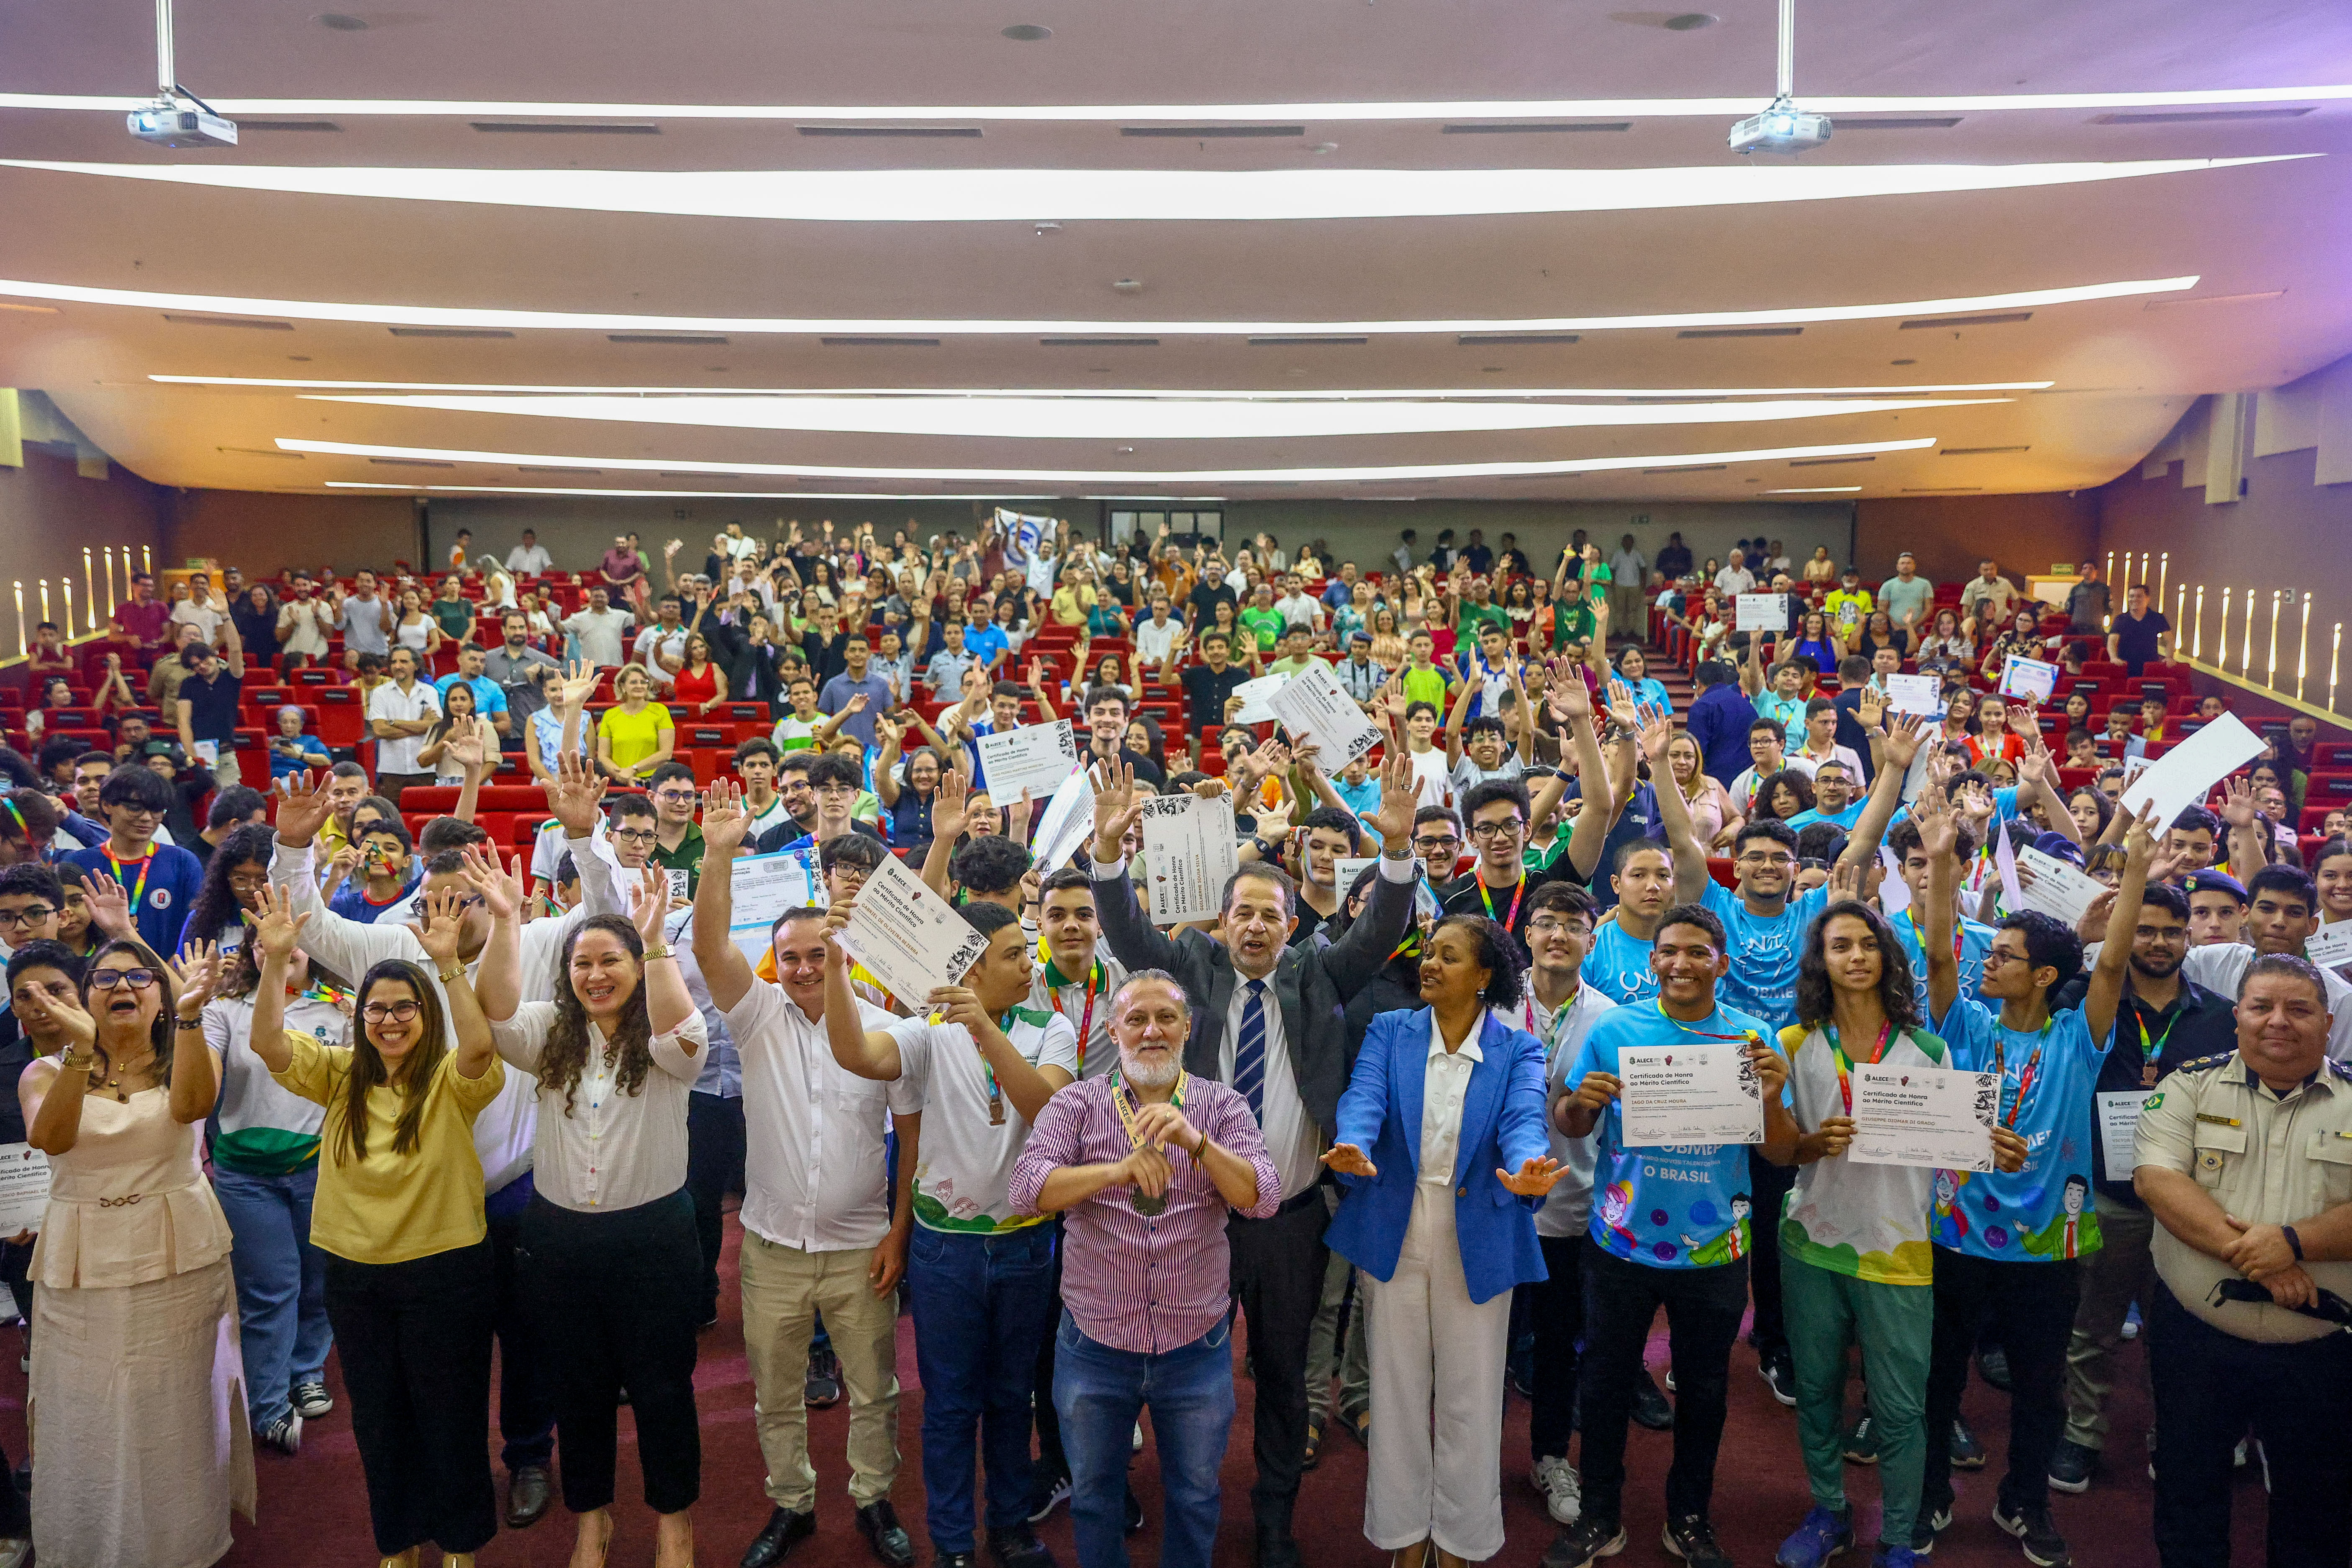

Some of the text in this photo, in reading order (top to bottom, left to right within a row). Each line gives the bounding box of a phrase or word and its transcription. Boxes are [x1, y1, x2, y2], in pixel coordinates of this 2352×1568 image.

[1306, 684, 1316, 698] Mérito
[1306, 676, 1322, 696] Certificado
[1326, 701, 1336, 713] Honra
[987, 751, 1010, 760] Certificado
[893, 874, 907, 887] ALECE
[1173, 874, 1177, 882] de
[878, 881, 903, 906] Certificado
[910, 910, 924, 924] Honra
[880, 892, 895, 908] Mérito
[895, 907, 917, 928] Científico
[862, 903, 878, 919] GABRIEL
[883, 923, 901, 941] OLIVEIRA
[902, 940, 918, 956] BEZERRA
[1747, 985, 1793, 998] OBME
[1118, 1099, 1129, 1117] ALECE
[1644, 1165, 1711, 1183] O BRASIL
